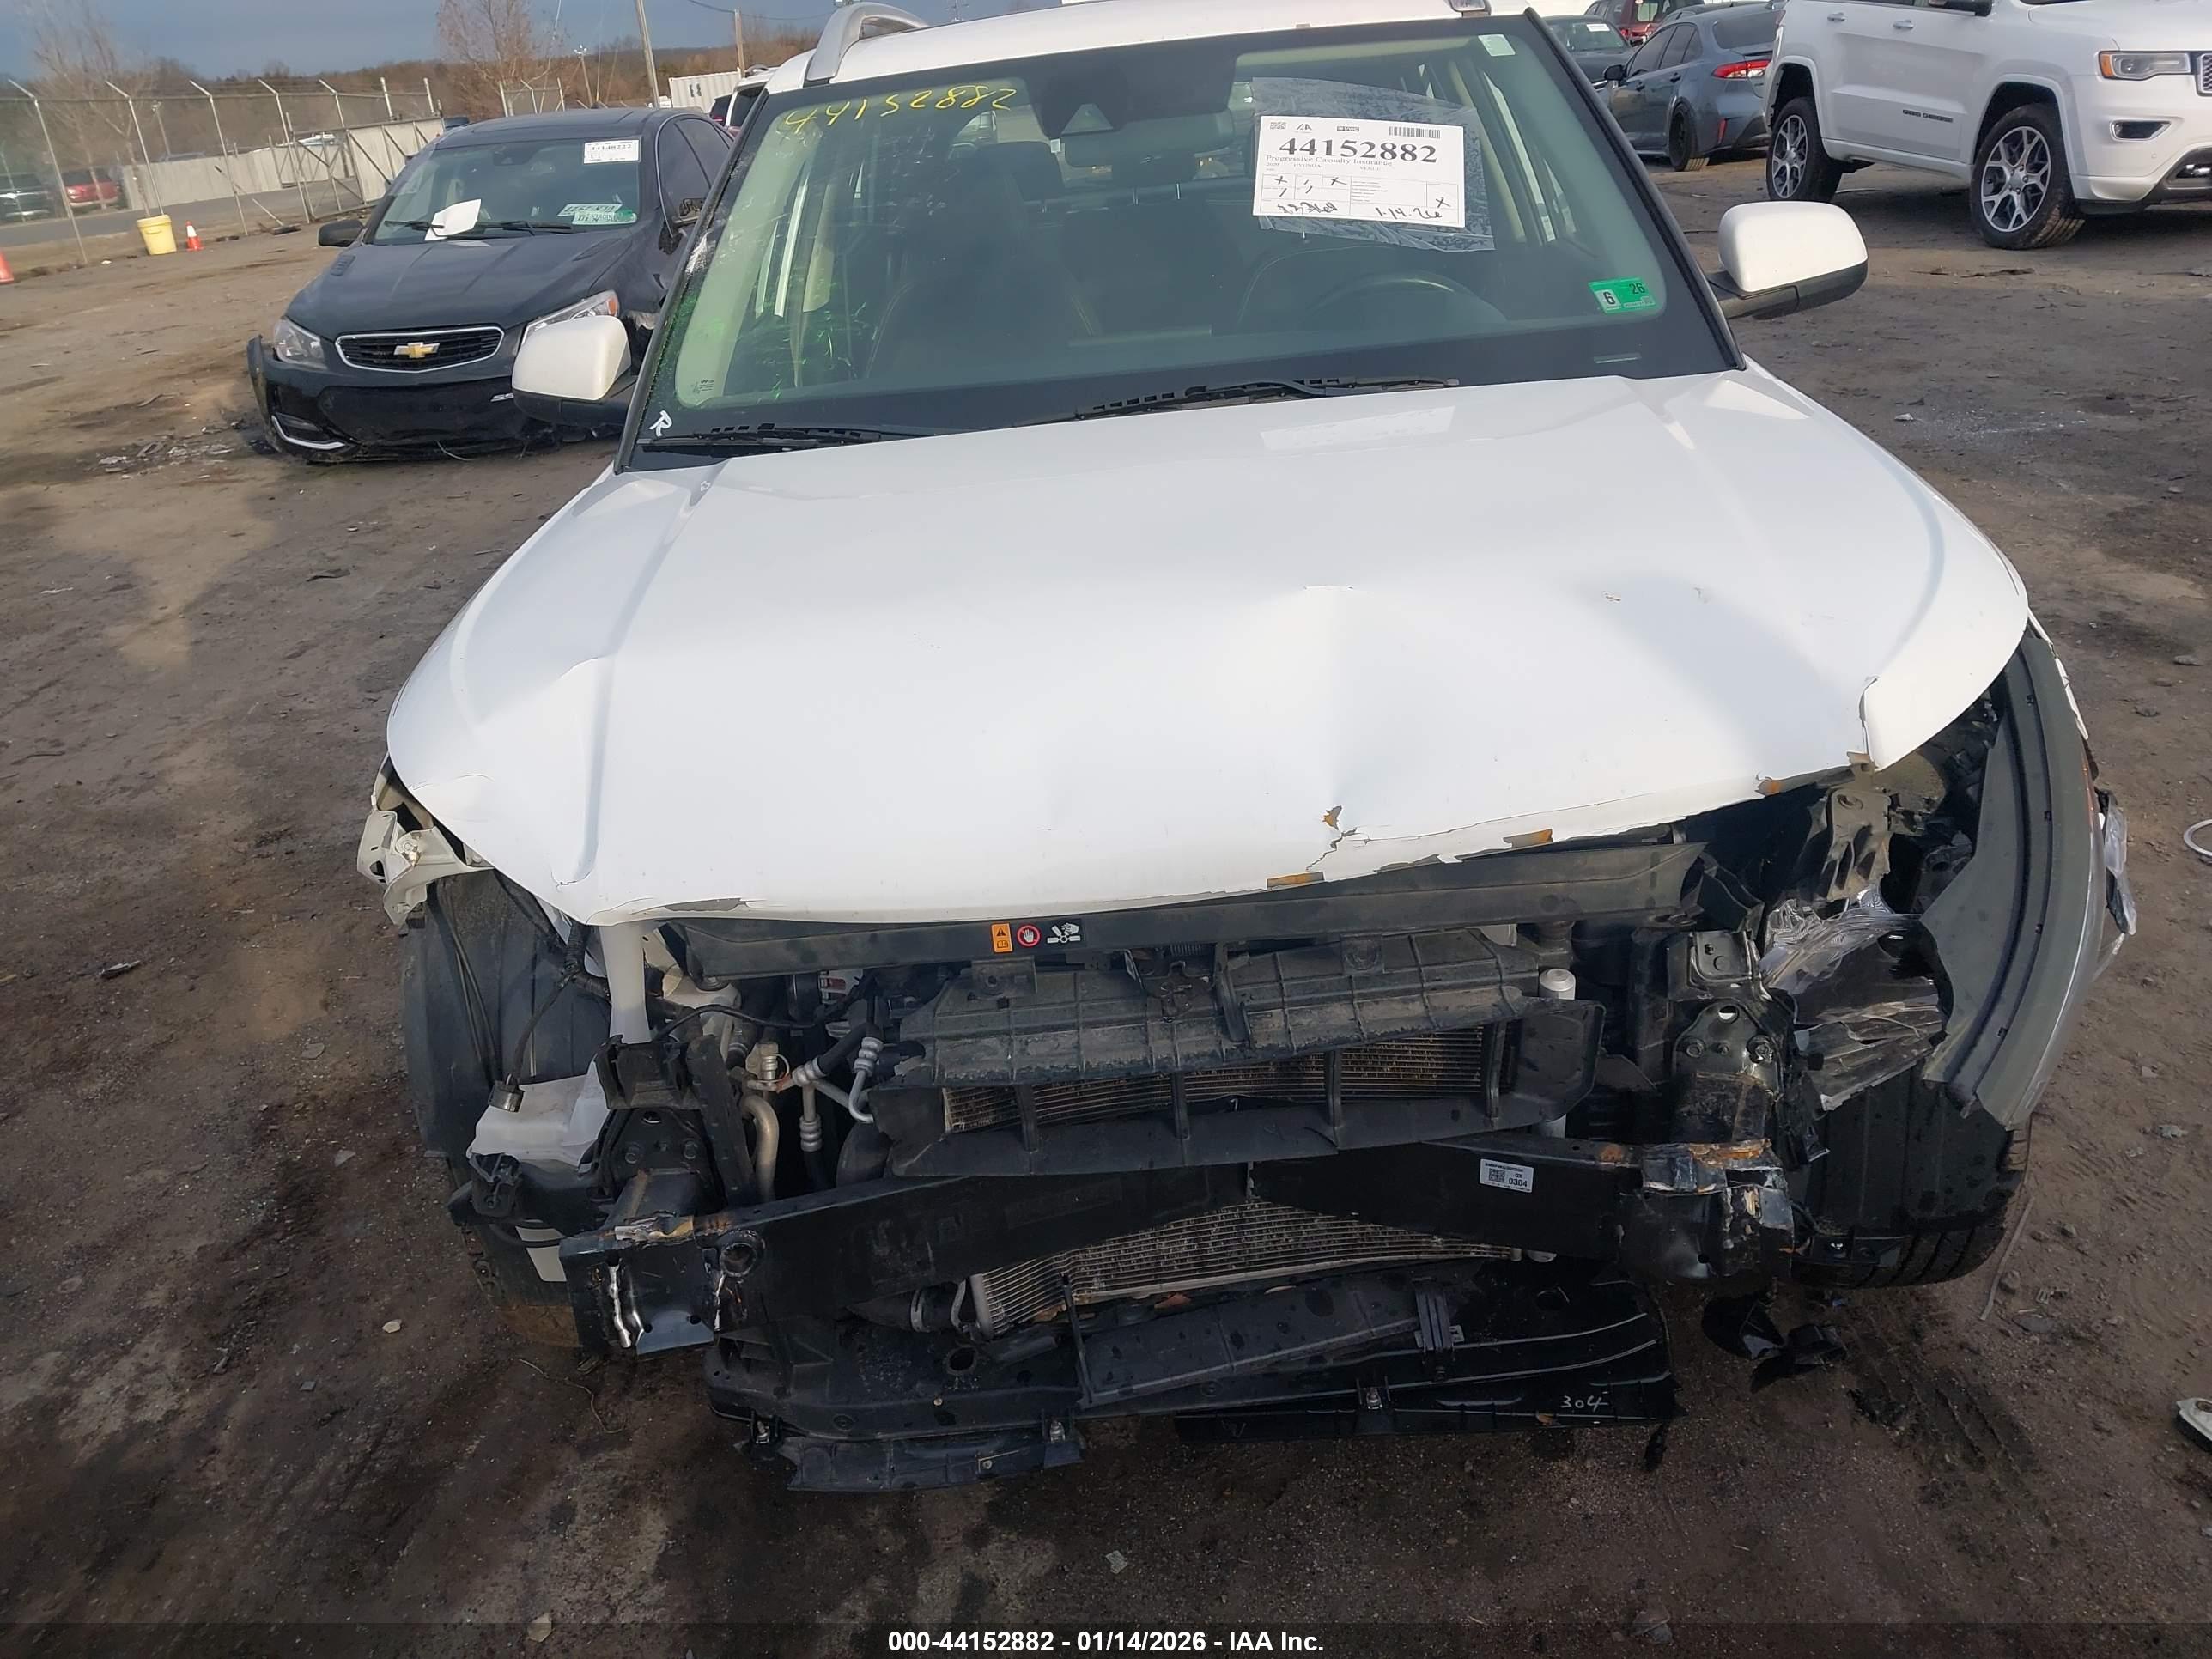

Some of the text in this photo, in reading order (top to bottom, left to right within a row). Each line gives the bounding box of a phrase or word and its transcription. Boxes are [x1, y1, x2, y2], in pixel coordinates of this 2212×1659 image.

[784, 83, 1017, 135] 44152882
[1279, 137, 1438, 164] 44152882
[1266, 155, 1314, 163] Progressive
[1316, 156, 1352, 166] Casualty
[1628, 282, 1646, 295] 26
[1602, 291, 1616, 305] 6
[648, 410, 673, 437] R
[1508, 1177, 1528, 1188] 0304
[1559, 1395, 1608, 1413] 304
